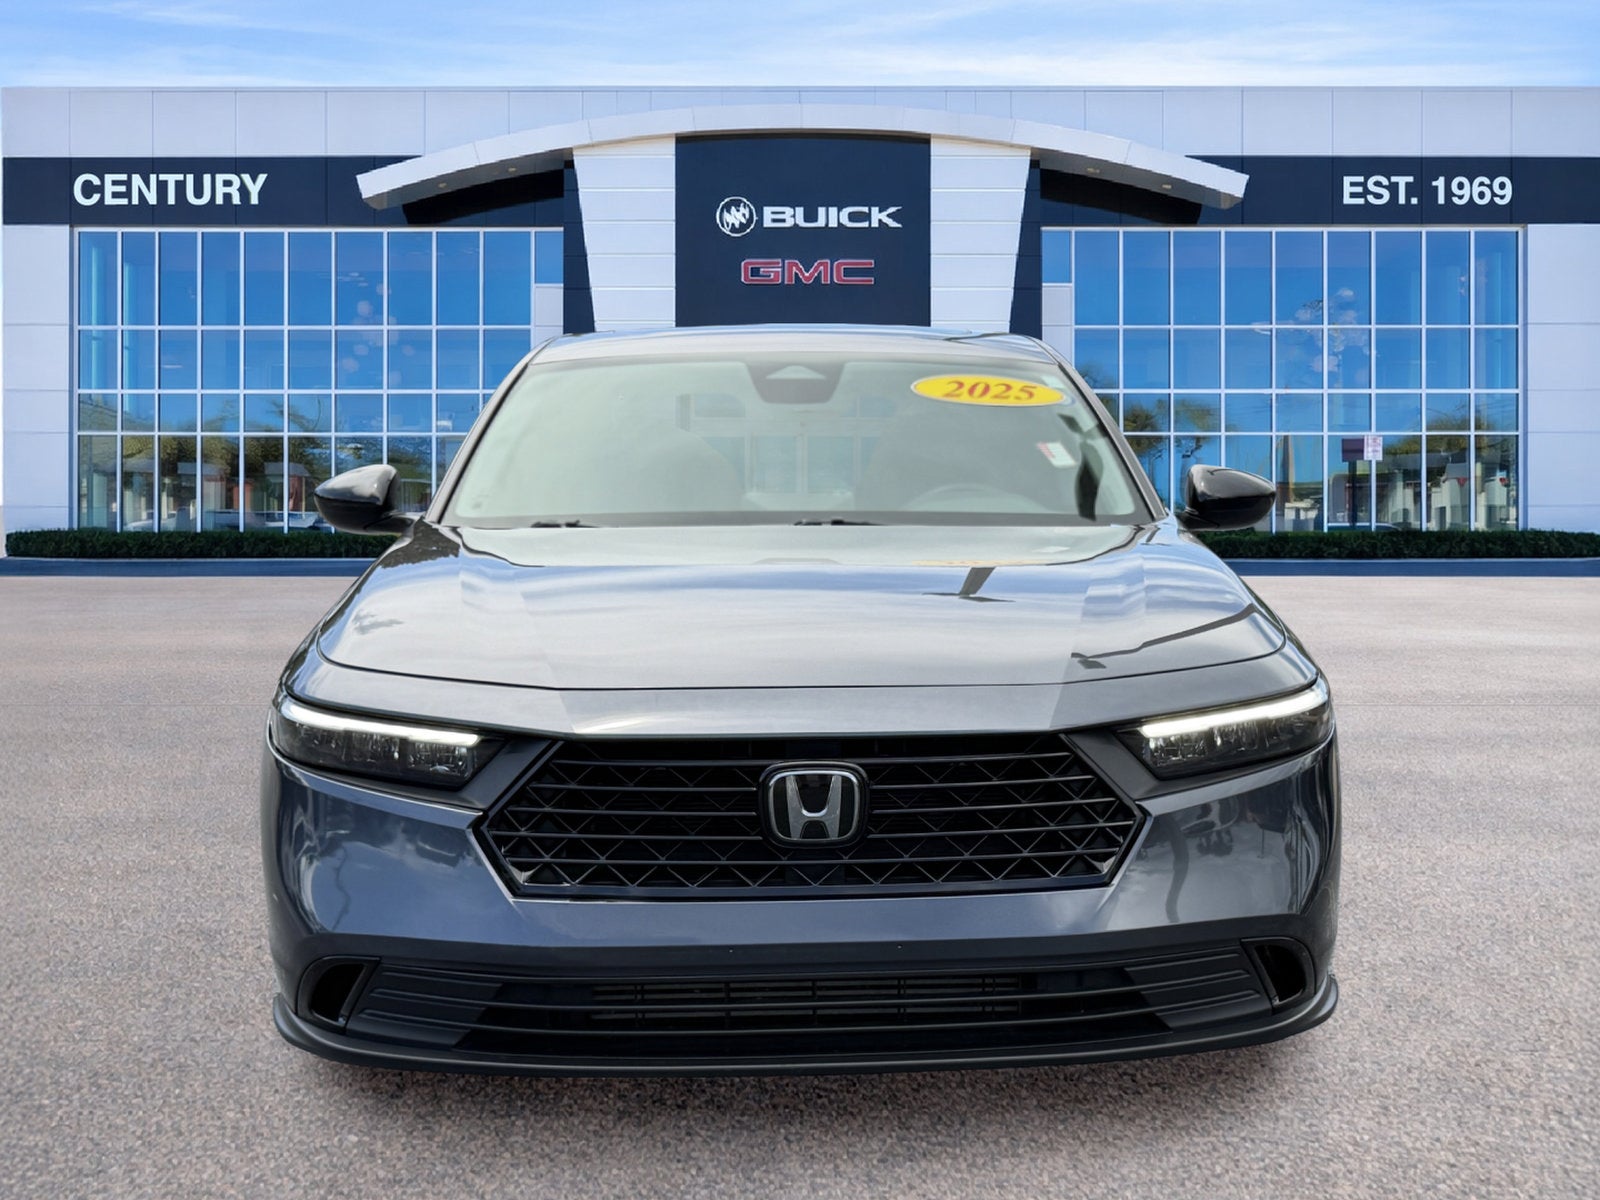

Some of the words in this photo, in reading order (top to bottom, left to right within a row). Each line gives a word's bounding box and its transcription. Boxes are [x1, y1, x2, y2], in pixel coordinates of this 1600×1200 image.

[73, 173, 268, 206] CENTURY
[1342, 175, 1418, 205] EST.
[1431, 175, 1513, 206] 1969
[762, 206, 903, 228] BUICK
[741, 259, 874, 284] GMC
[942, 380, 1037, 401] 2025
